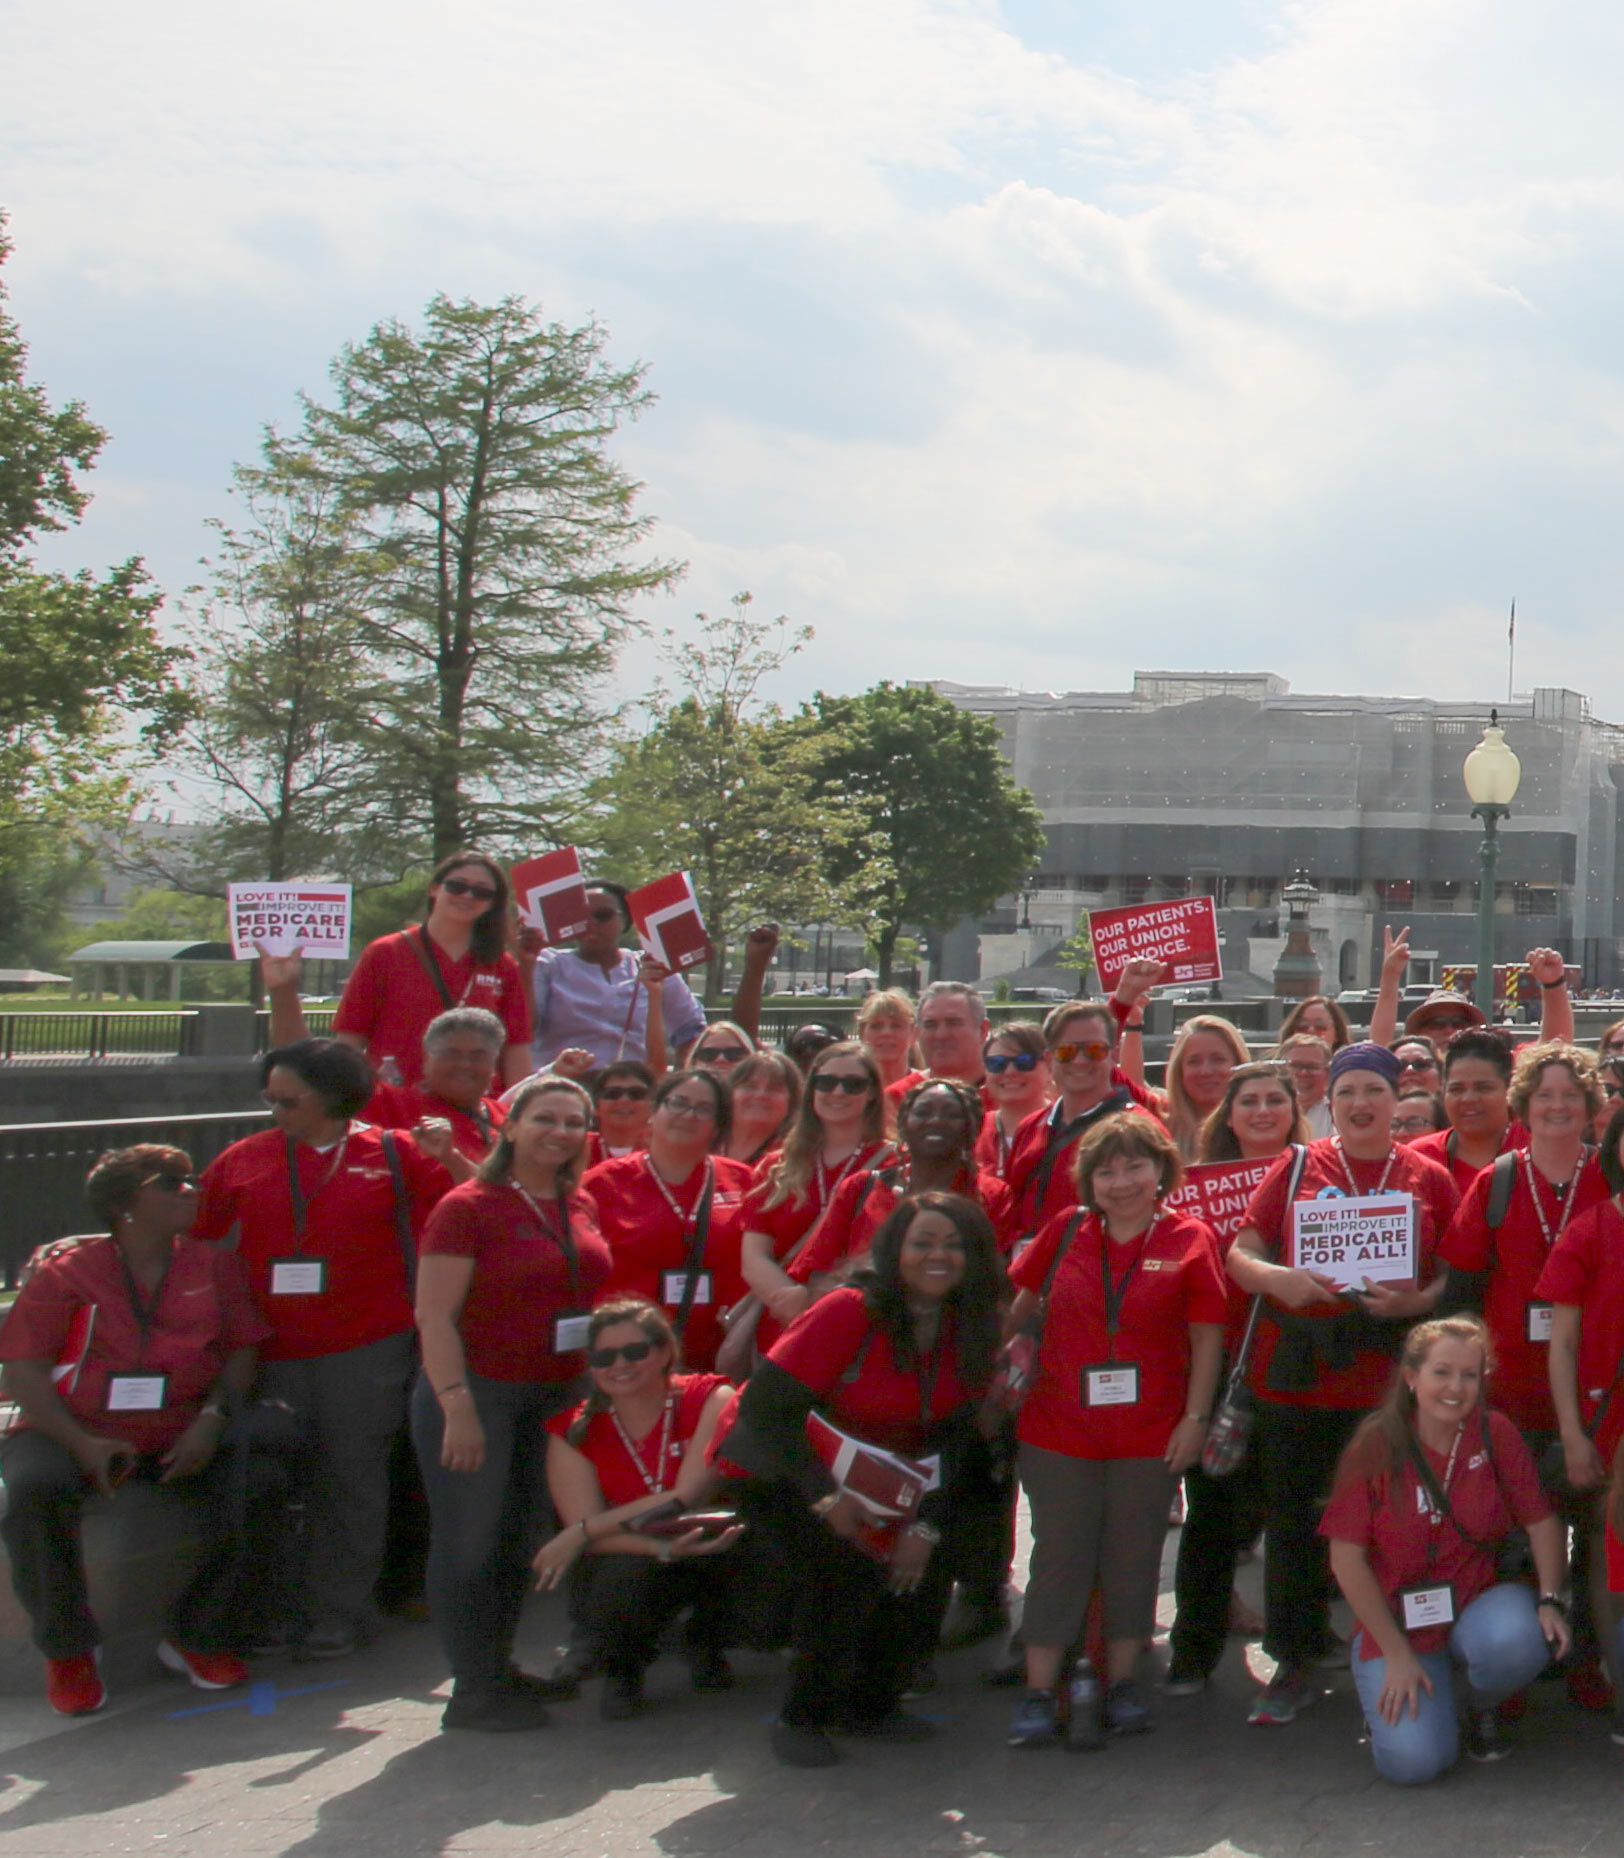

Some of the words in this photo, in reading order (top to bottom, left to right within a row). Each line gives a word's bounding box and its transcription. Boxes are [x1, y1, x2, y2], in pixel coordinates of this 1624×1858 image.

[236, 892, 275, 902] LOVE
[279, 892, 296, 901] IT!
[261, 902, 326, 913] IMPROVE
[327, 903, 346, 913] IT!
[237, 913, 345, 926] MEDICARE
[1095, 922, 1125, 941] OUR
[1127, 900, 1209, 931] PATIENTS.
[238, 926, 283, 939] FOR
[295, 926, 344, 940] ALL!
[1099, 938, 1128, 957] OUR
[1131, 922, 1190, 947] UNION.
[1204, 1166, 1271, 1196] PATIE
[1300, 1210, 1337, 1223] LOVE
[1341, 1209, 1358, 1220] IT!
[1324, 1218, 1387, 1233] IMPROVE
[1391, 1216, 1407, 1227] IT!
[1300, 1229, 1407, 1250] MEDICARE
[1300, 1249, 1345, 1266] FOR
[1356, 1243, 1407, 1261] ALL!
